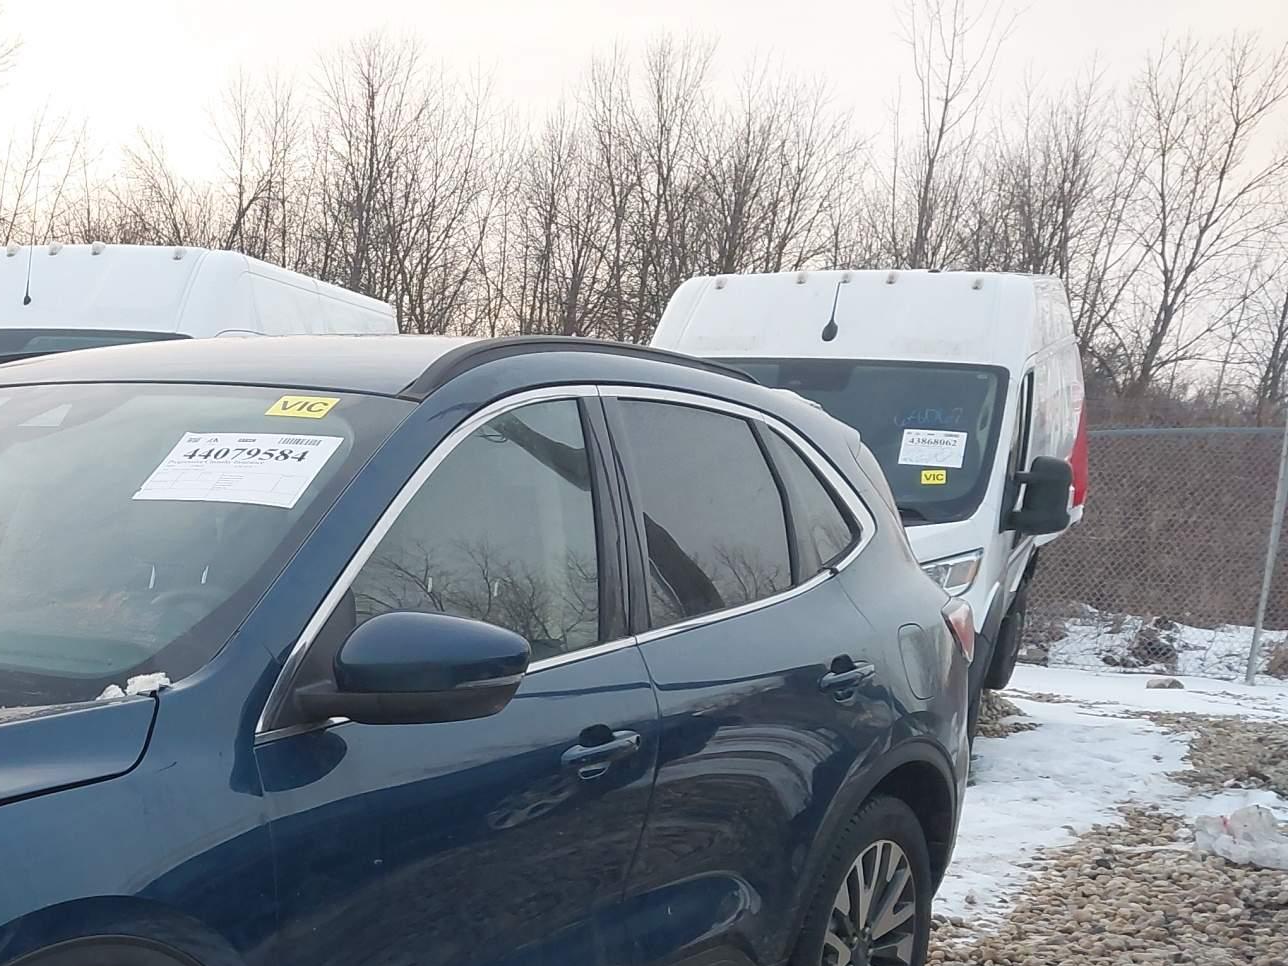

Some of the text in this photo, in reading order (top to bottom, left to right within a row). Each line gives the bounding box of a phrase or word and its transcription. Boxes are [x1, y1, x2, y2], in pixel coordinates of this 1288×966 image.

[281, 400, 329, 413] VIC
[183, 447, 310, 462] 44079584
[923, 473, 945, 481] VIC
